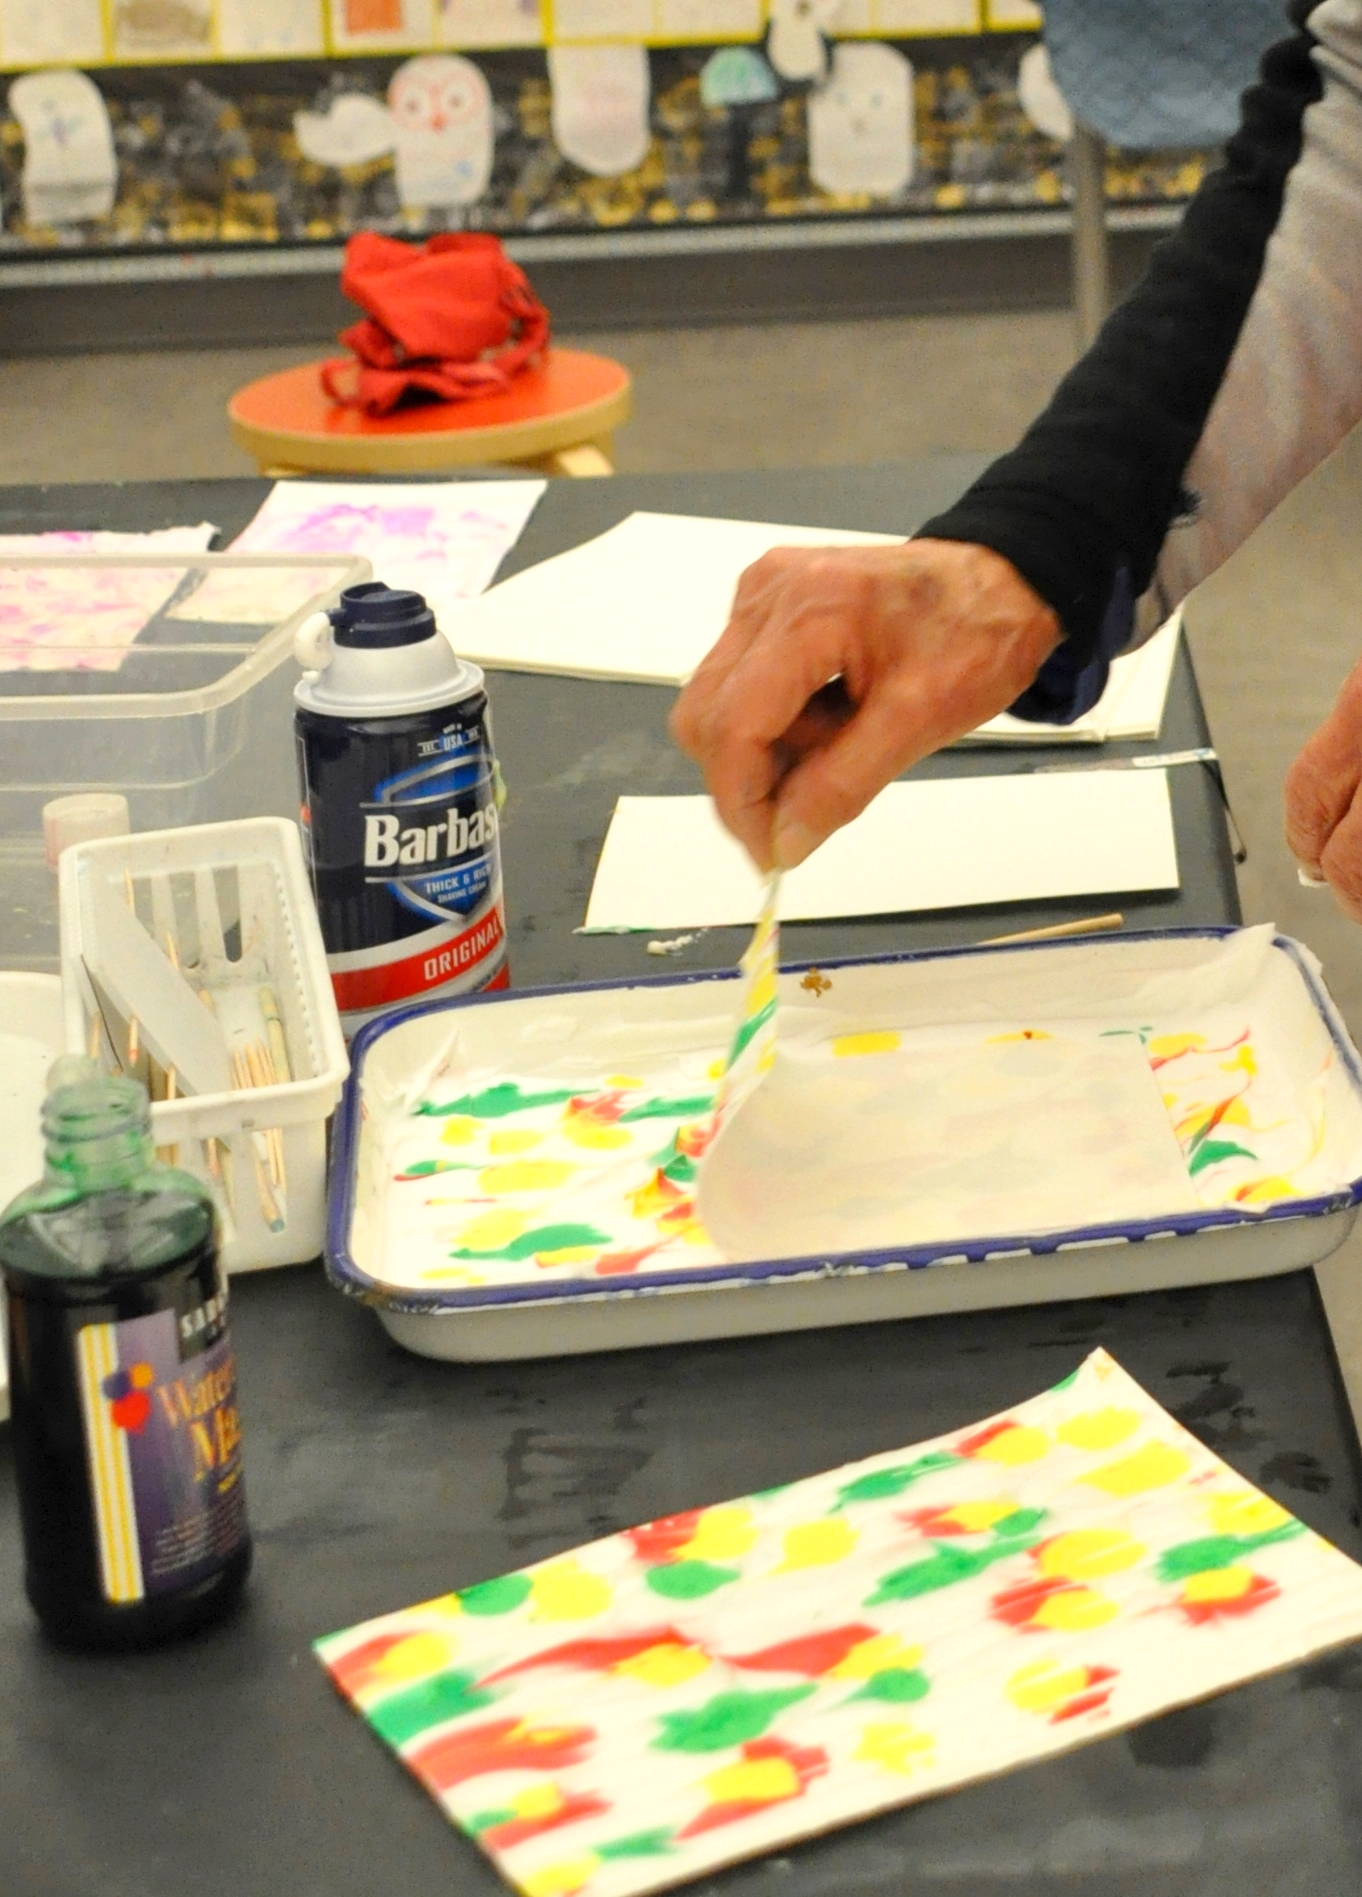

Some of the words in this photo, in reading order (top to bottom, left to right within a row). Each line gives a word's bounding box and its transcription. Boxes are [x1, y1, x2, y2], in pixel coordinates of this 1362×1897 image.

[443, 733, 464, 751] USA
[425, 879, 460, 894] THICK
[423, 915, 500, 981] ORIGINAL
